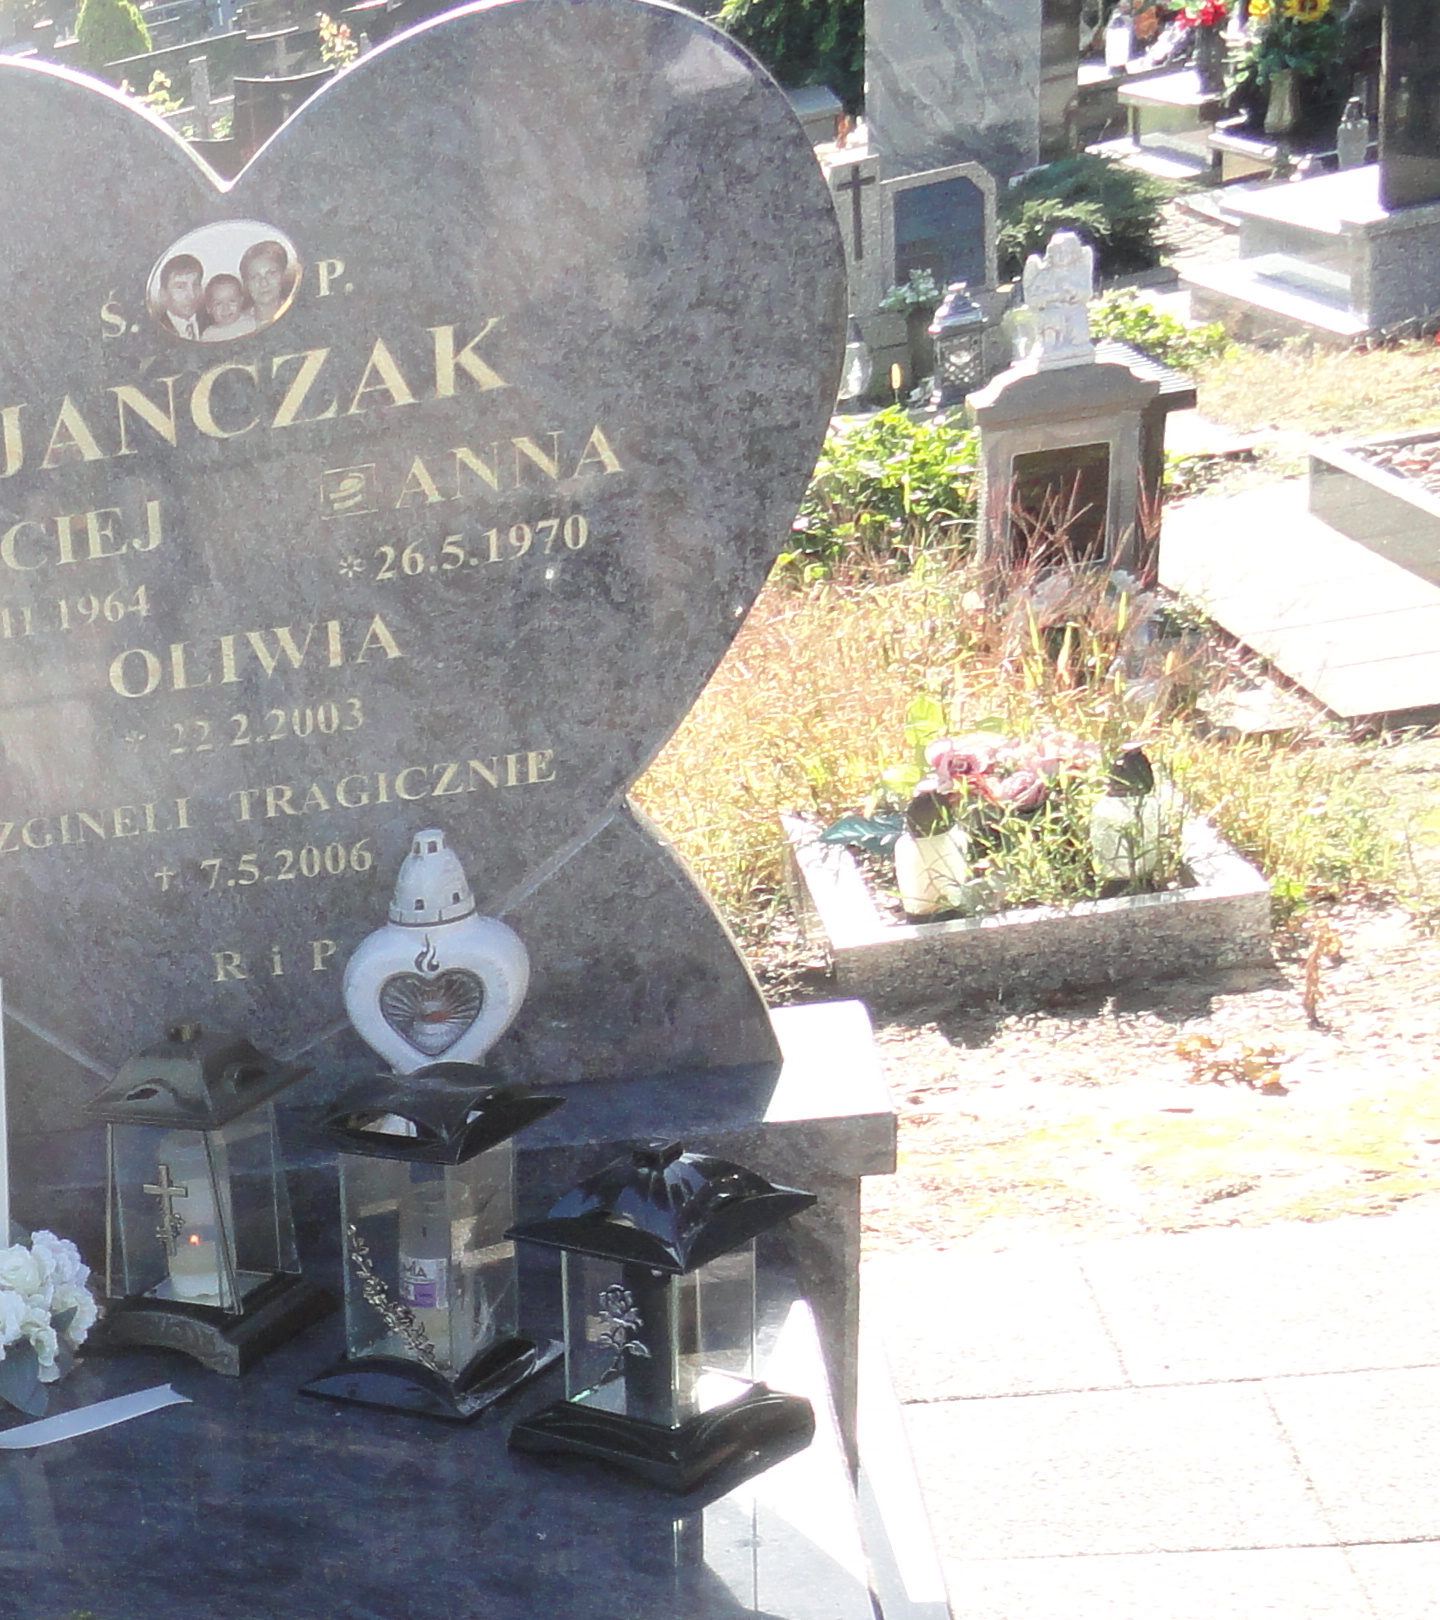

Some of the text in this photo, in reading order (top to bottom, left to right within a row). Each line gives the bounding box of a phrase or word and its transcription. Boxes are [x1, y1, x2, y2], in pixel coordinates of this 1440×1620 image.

[316, 258, 355, 299] P.
[395, 423, 626, 509] ANNA
[373, 513, 589, 581] 26.5.1970
[108, 612, 407, 699] OLIWIA
[169, 698, 366, 755] 222.2003
[228, 748, 558, 823] TRAGICZNIE
[199, 837, 375, 890] 7.5.2006
